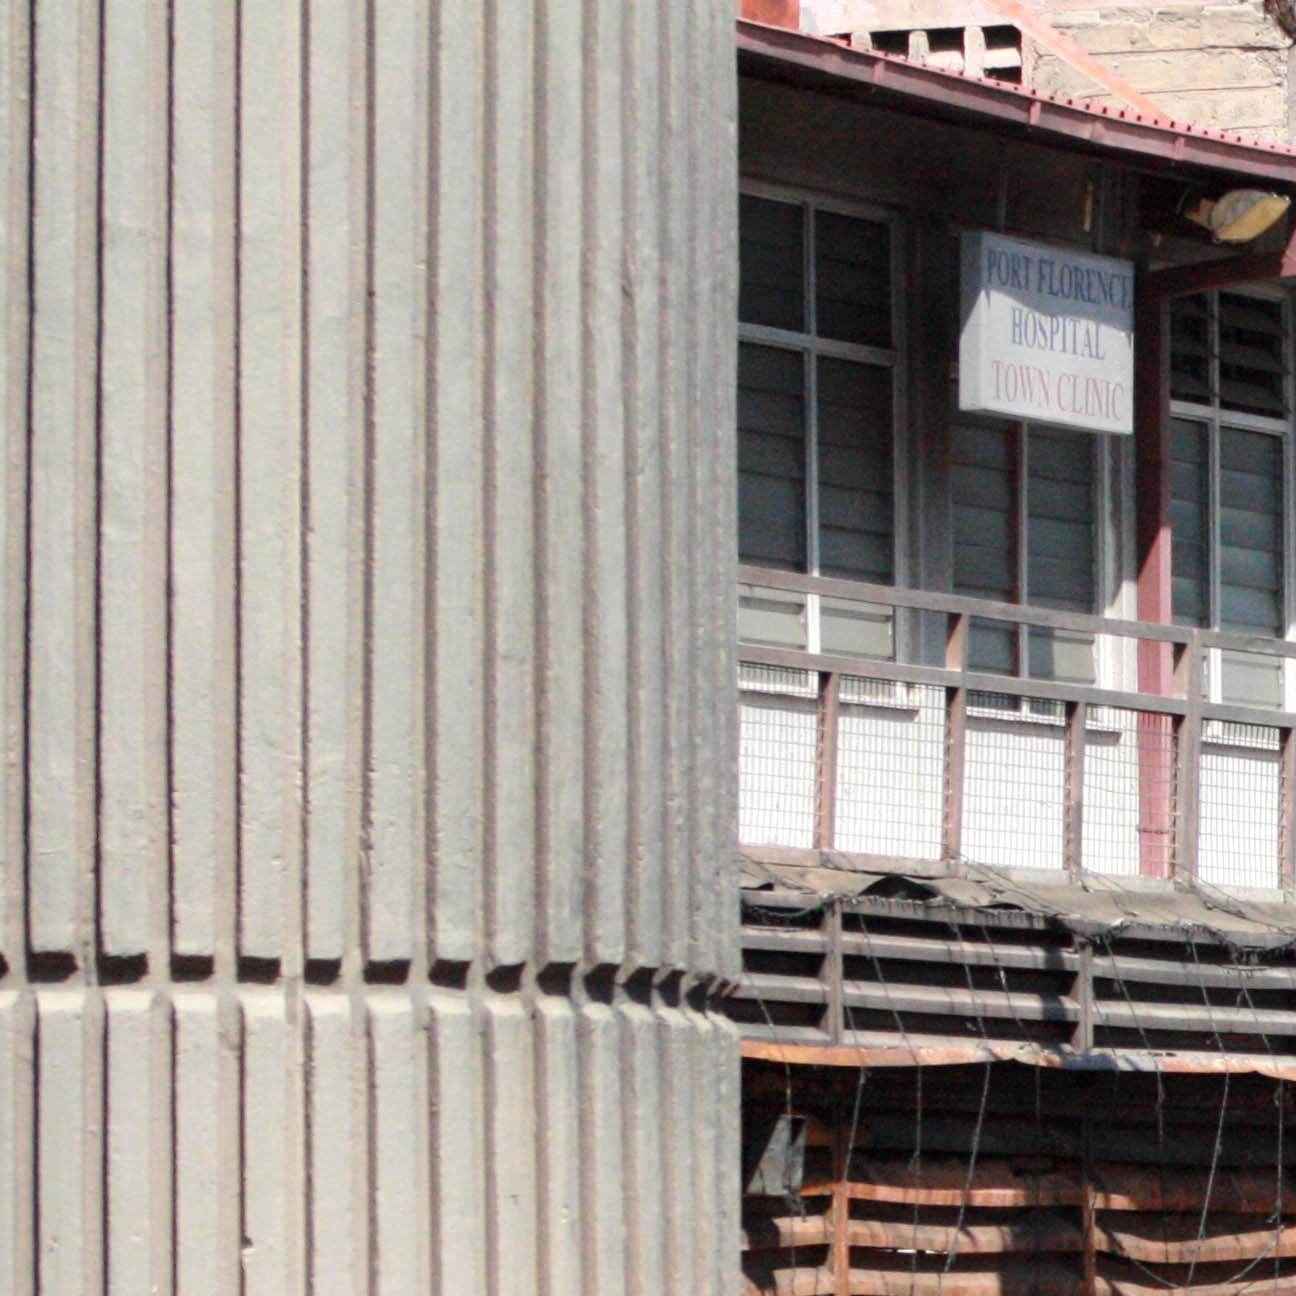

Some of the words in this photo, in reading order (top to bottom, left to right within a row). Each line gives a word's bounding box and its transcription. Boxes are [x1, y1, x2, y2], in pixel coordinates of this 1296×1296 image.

[986, 249, 1031, 291] PORT
[1011, 305, 1106, 361] HOSPITAL
[992, 360, 1050, 408] TOWN
[1056, 371, 1126, 421] CLINIC
